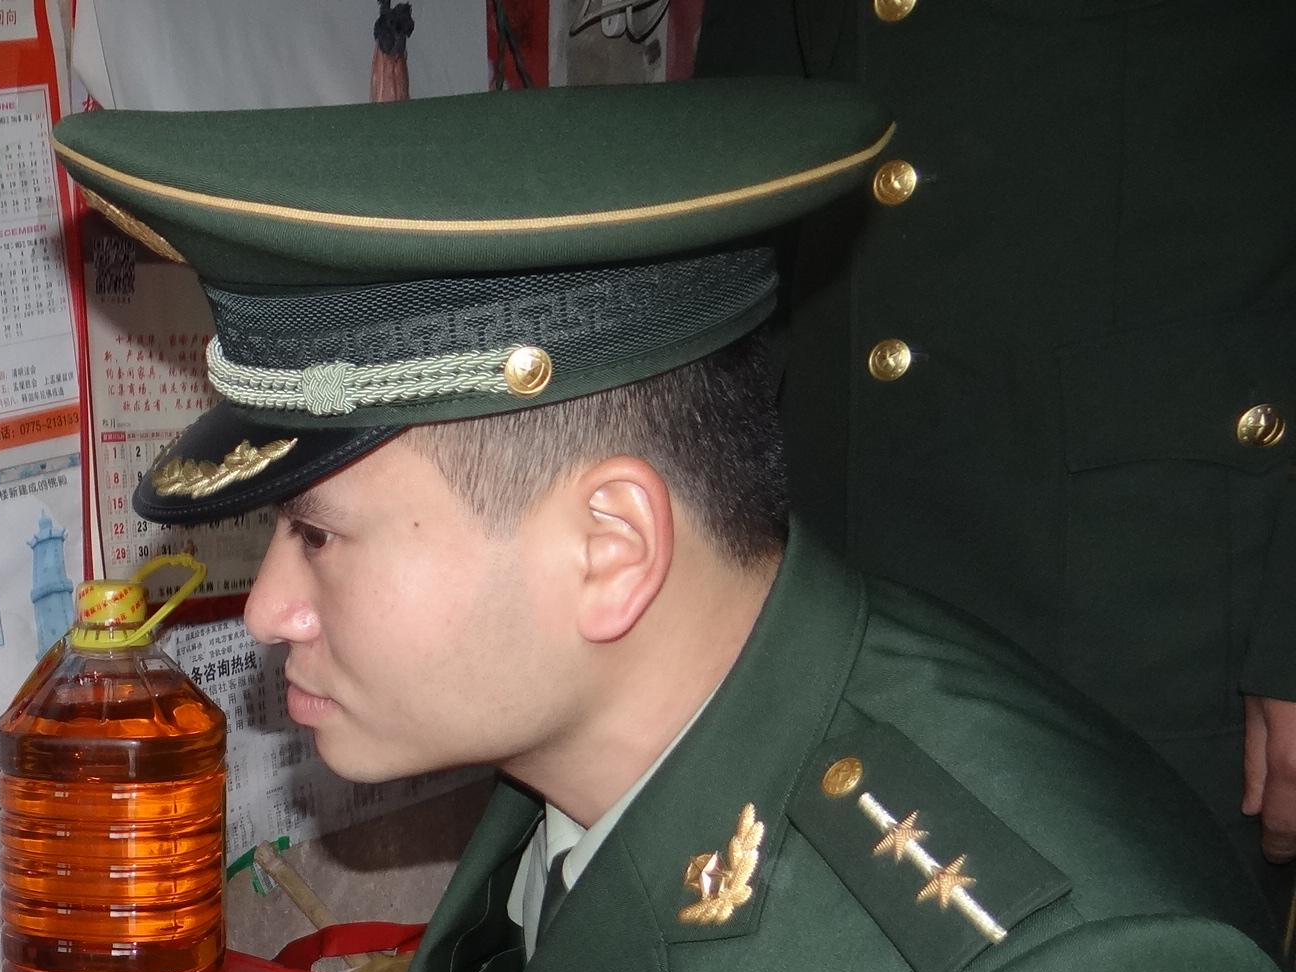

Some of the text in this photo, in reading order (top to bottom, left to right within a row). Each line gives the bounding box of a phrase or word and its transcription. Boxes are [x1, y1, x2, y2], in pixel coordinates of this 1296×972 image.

[135, 446, 141, 457] 2
[113, 472, 120, 484] 8
[113, 498, 123, 510] 15
[114, 523, 125, 534] 22
[137, 521, 147, 532] 23
[116, 548, 126, 559] 29
[138, 546, 149, 557] 30
